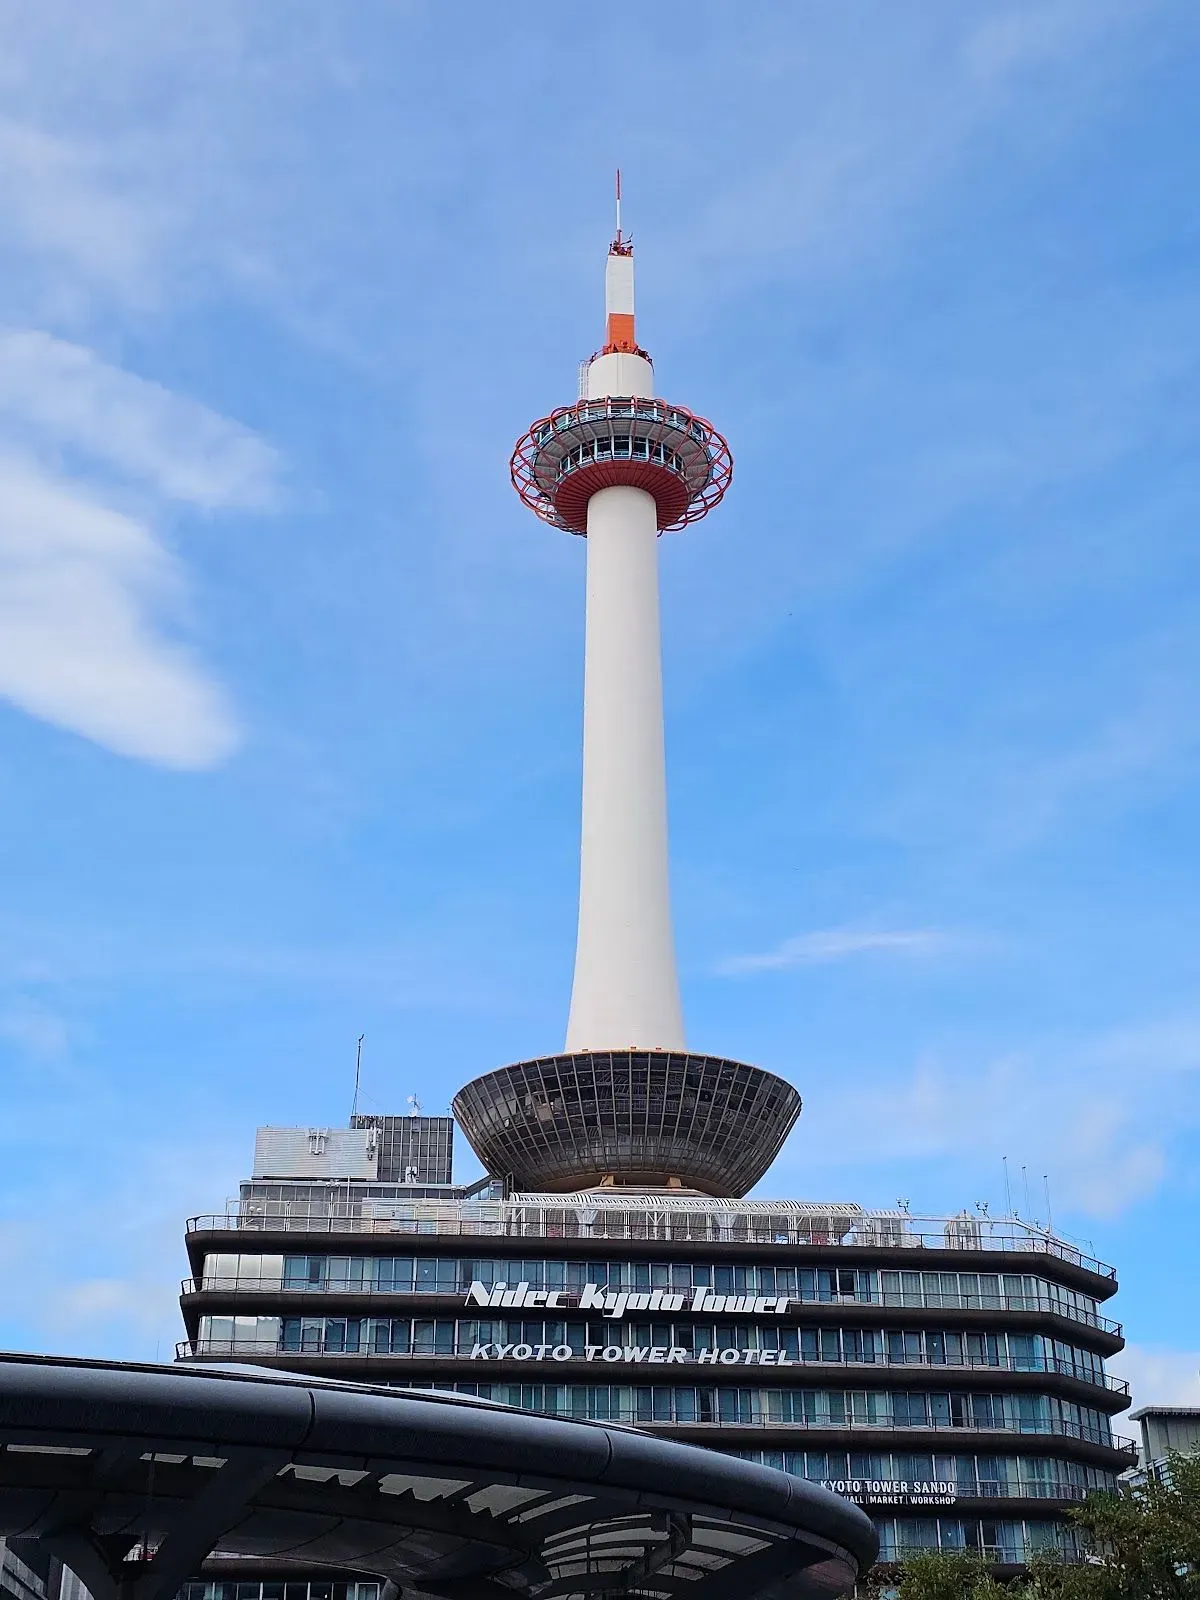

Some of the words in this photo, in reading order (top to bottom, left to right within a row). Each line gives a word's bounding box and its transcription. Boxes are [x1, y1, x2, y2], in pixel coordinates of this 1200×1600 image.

[464, 1280, 570, 1308] Nidec
[578, 1284, 684, 1318] Kyoto
[690, 1286, 796, 1314] Tower
[470, 1343, 573, 1361] KYOTO
[584, 1345, 687, 1363] TOWER
[698, 1348, 794, 1366] HOTEL
[820, 1480, 860, 1493] KYOTO
[865, 1481, 908, 1493] TOWER
[913, 1481, 955, 1493] SANDO
[870, 1496, 903, 1504] MARKET
[911, 1496, 956, 1504] WORKSHOP
